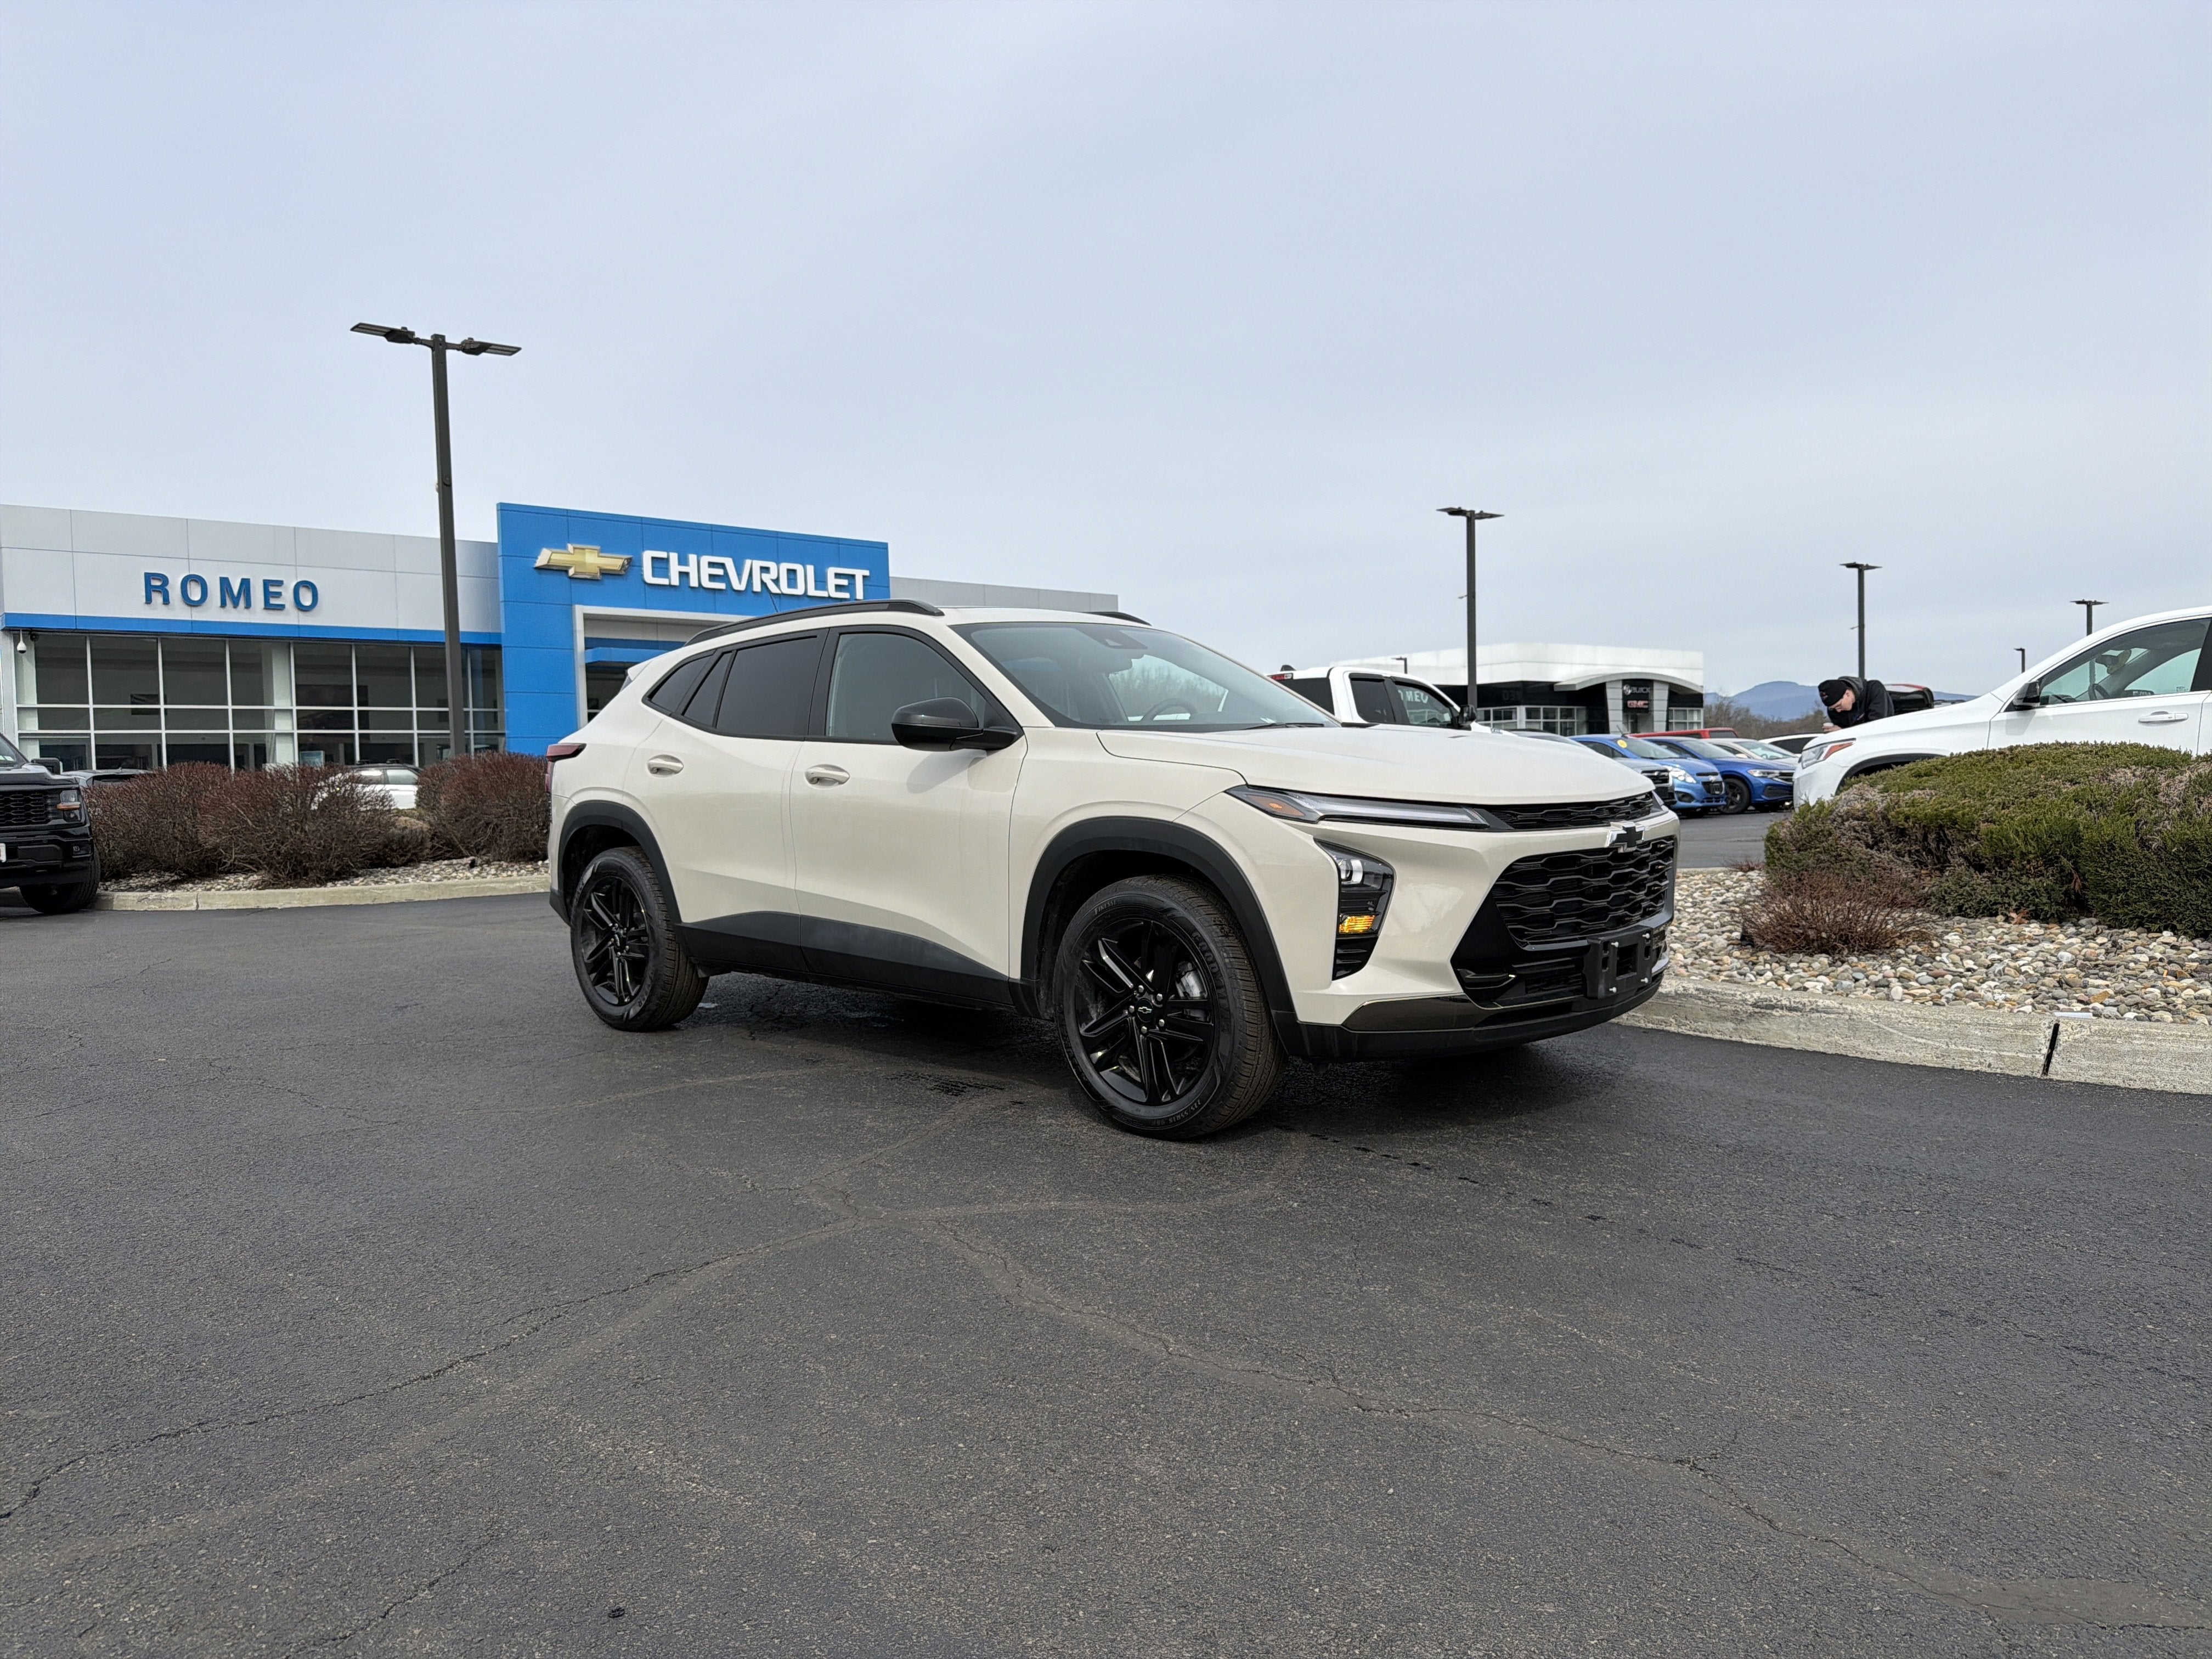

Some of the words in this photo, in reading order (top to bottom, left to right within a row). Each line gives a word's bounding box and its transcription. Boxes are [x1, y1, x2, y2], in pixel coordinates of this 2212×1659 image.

[144, 572, 319, 612] ROMEO
[642, 550, 870, 601] CHEVROLET
[1627, 700, 1649, 709] GMC
